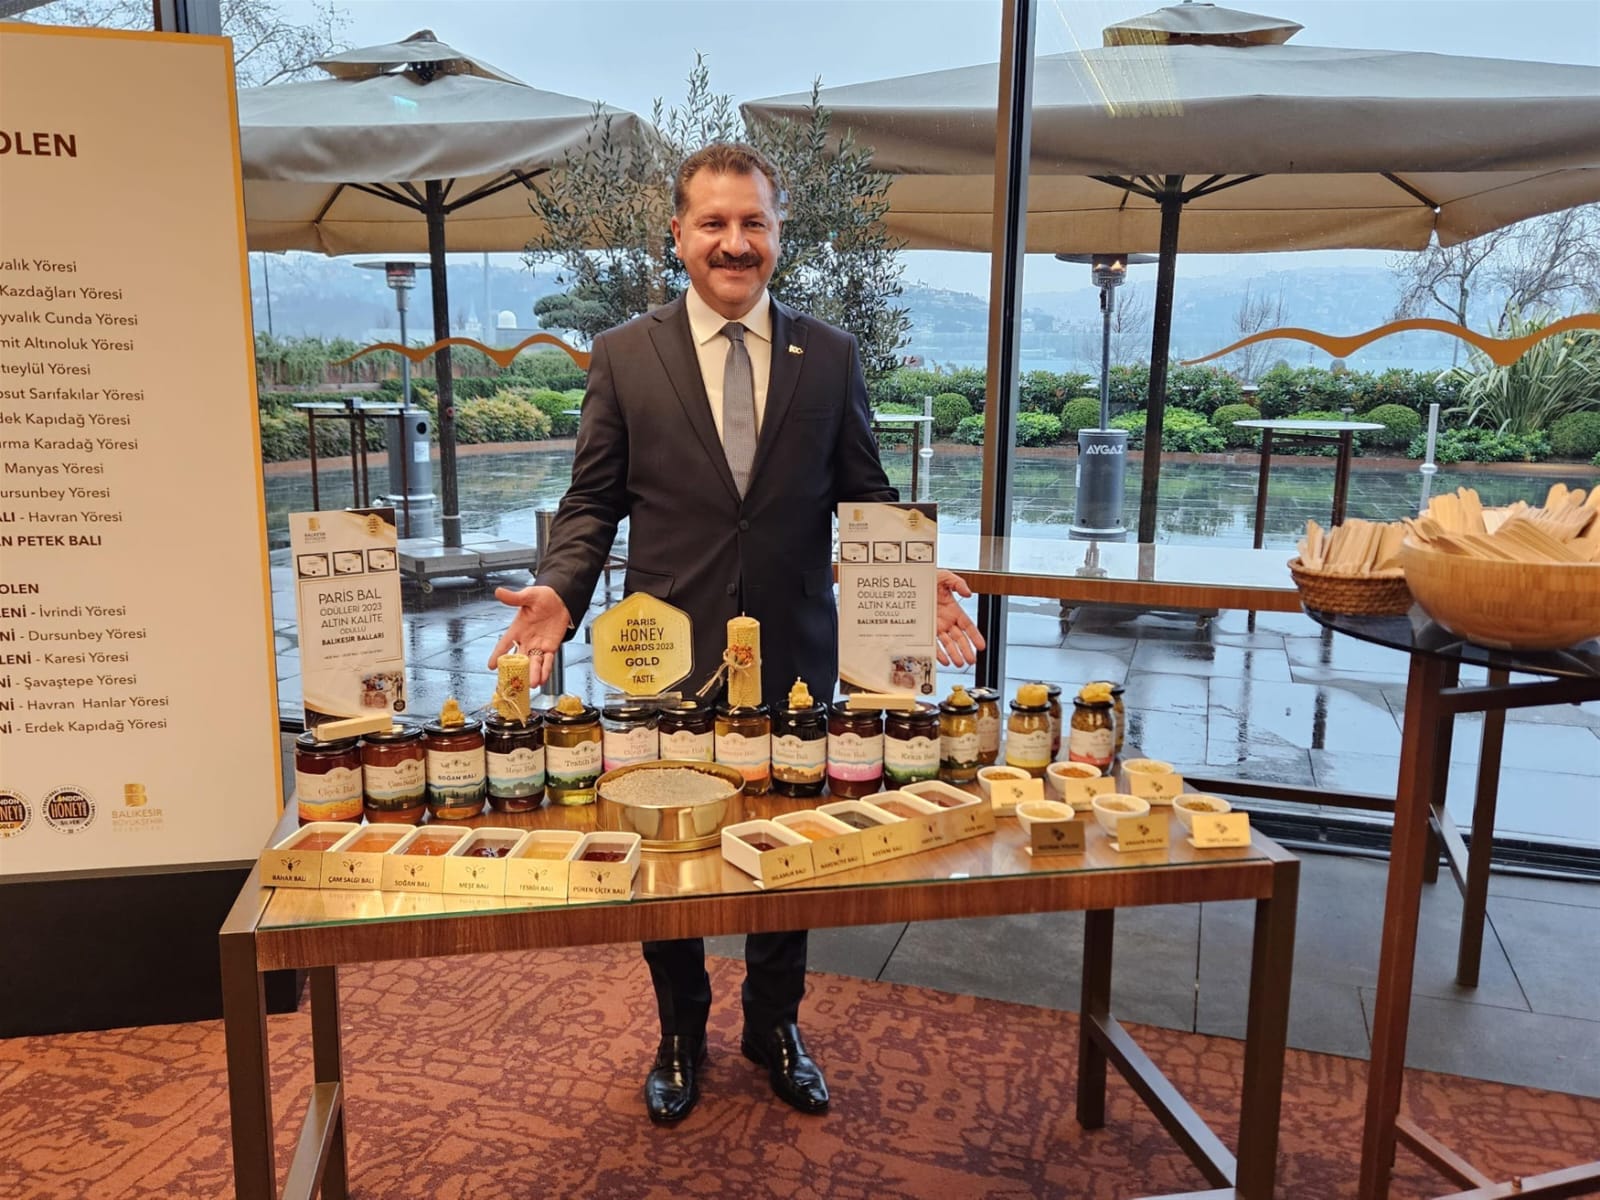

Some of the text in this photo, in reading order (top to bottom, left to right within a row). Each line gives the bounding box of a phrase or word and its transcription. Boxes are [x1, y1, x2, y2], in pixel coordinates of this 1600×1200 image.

[33, 259, 77, 273] Yöresi
[0, 285, 122, 301] Kazdağları Yöresi
[45, 312, 92, 325] Cunda
[95, 313, 138, 326] Yöresi
[24, 336, 88, 350] Altınoluk
[91, 338, 134, 351] Yöresi
[48, 362, 91, 375] Yöresi
[29, 387, 99, 401] Sarıfakılar
[102, 388, 145, 401] Yöresi
[25, 413, 85, 428] Kapıdağ
[88, 413, 131, 426] Yöresi
[34, 438, 93, 453] Karadağ
[97, 438, 138, 450] Yöresi
[1086, 445, 1123, 455] AYGAZ
[4, 462, 104, 477] Manyas Yöresi
[68, 487, 110, 499] Yöresi
[28, 511, 78, 523] Havran
[80, 511, 123, 522] Yöresi
[17, 535, 65, 546] PETEK
[69, 535, 102, 546] BALI
[893, 576, 917, 588] BAL
[357, 588, 382, 601] BAL
[897, 590, 917, 599] 2023
[39, 604, 82, 617] İvrindi
[85, 605, 126, 617] Yöresi
[362, 602, 382, 612] 2023
[626, 618, 656, 626] PARIS
[28, 629, 103, 643] Dursunbey
[105, 628, 147, 640] Yöresi
[620, 627, 664, 642] HONEY
[611, 642, 674, 652] AWARDS 2023
[44, 653, 86, 665] Karesi
[88, 652, 129, 663] Yöresi
[625, 656, 660, 667] GOLD
[24, 676, 94, 690] Şavaştepe
[97, 674, 137, 686] Yöresi
[632, 674, 656, 684] TASTE
[27, 699, 75, 711] Havran
[82, 697, 126, 709] Hanlar
[129, 695, 169, 707] Yöresi
[25, 721, 65, 734] Erdek
[68, 720, 124, 734] Kapıdağ
[127, 718, 167, 730] Yöresi
[50, 801, 82, 818] HONEY
